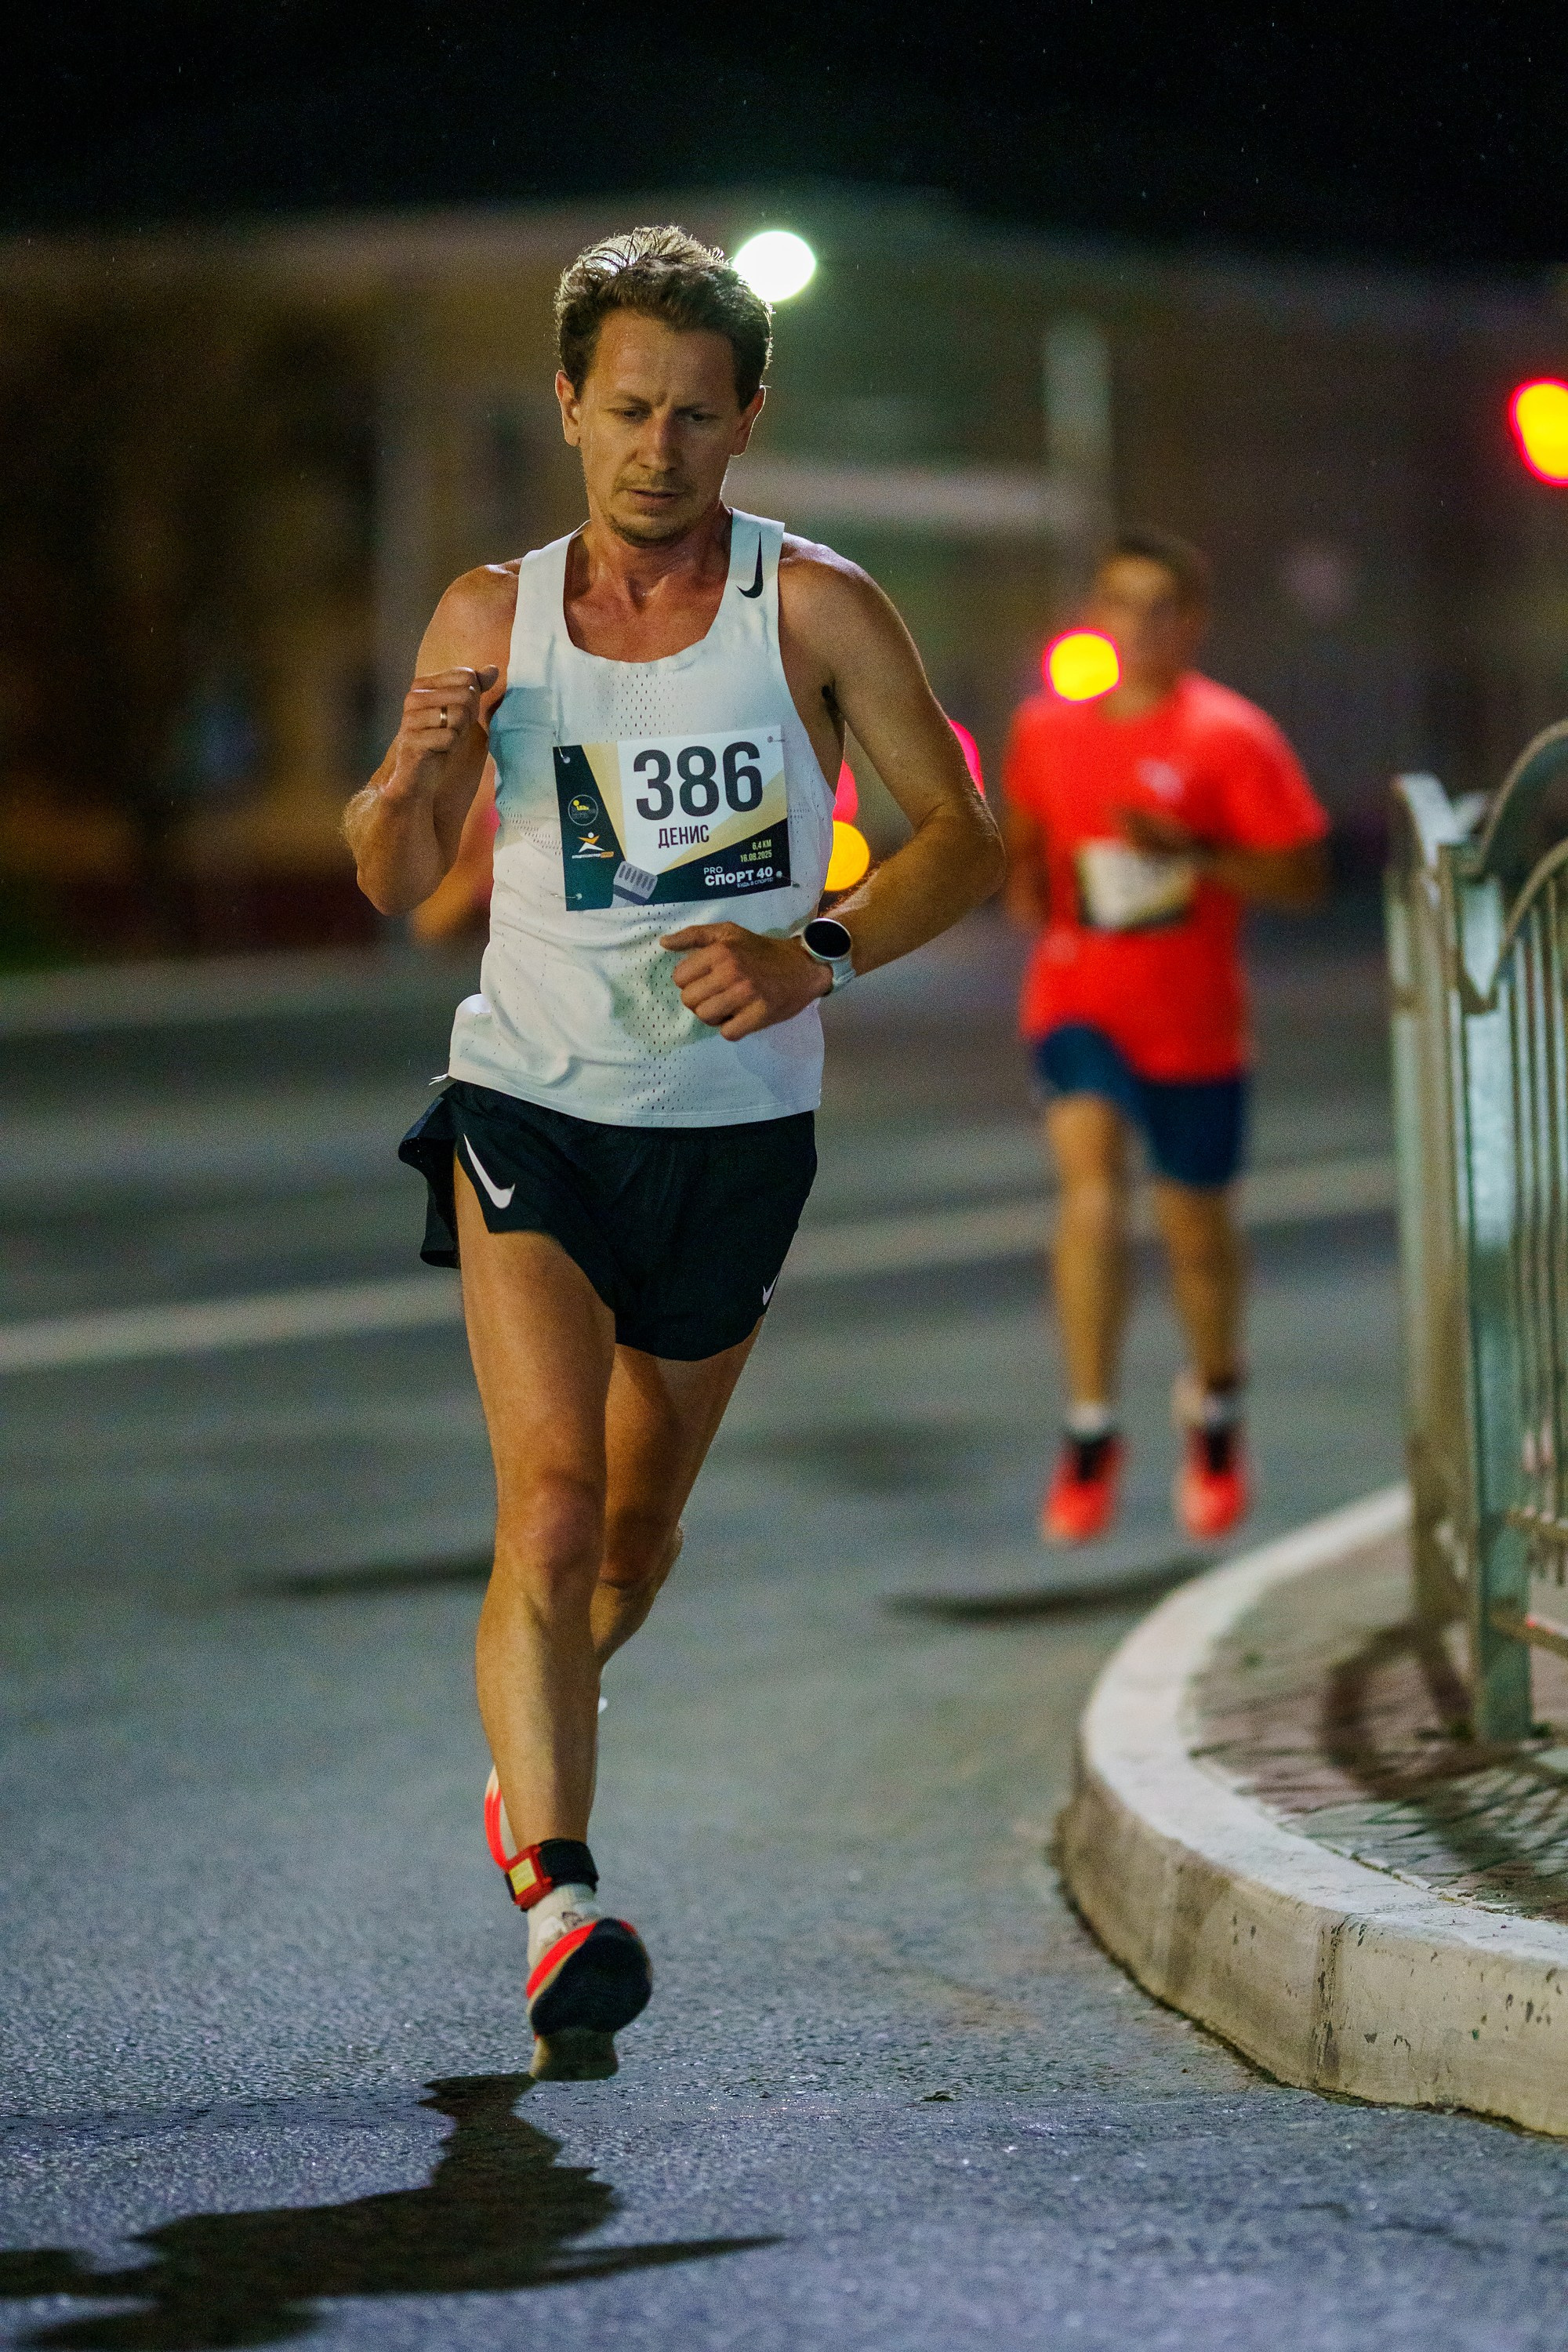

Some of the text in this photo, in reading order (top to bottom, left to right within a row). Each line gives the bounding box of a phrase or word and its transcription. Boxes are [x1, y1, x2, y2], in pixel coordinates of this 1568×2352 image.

[633, 741, 763, 821] 386
[659, 825, 710, 849] ДЕНИС
[762, 839, 772, 848] КМ
[703, 866, 724, 875] PRO
[705, 866, 773, 887] СПОРТ 40
